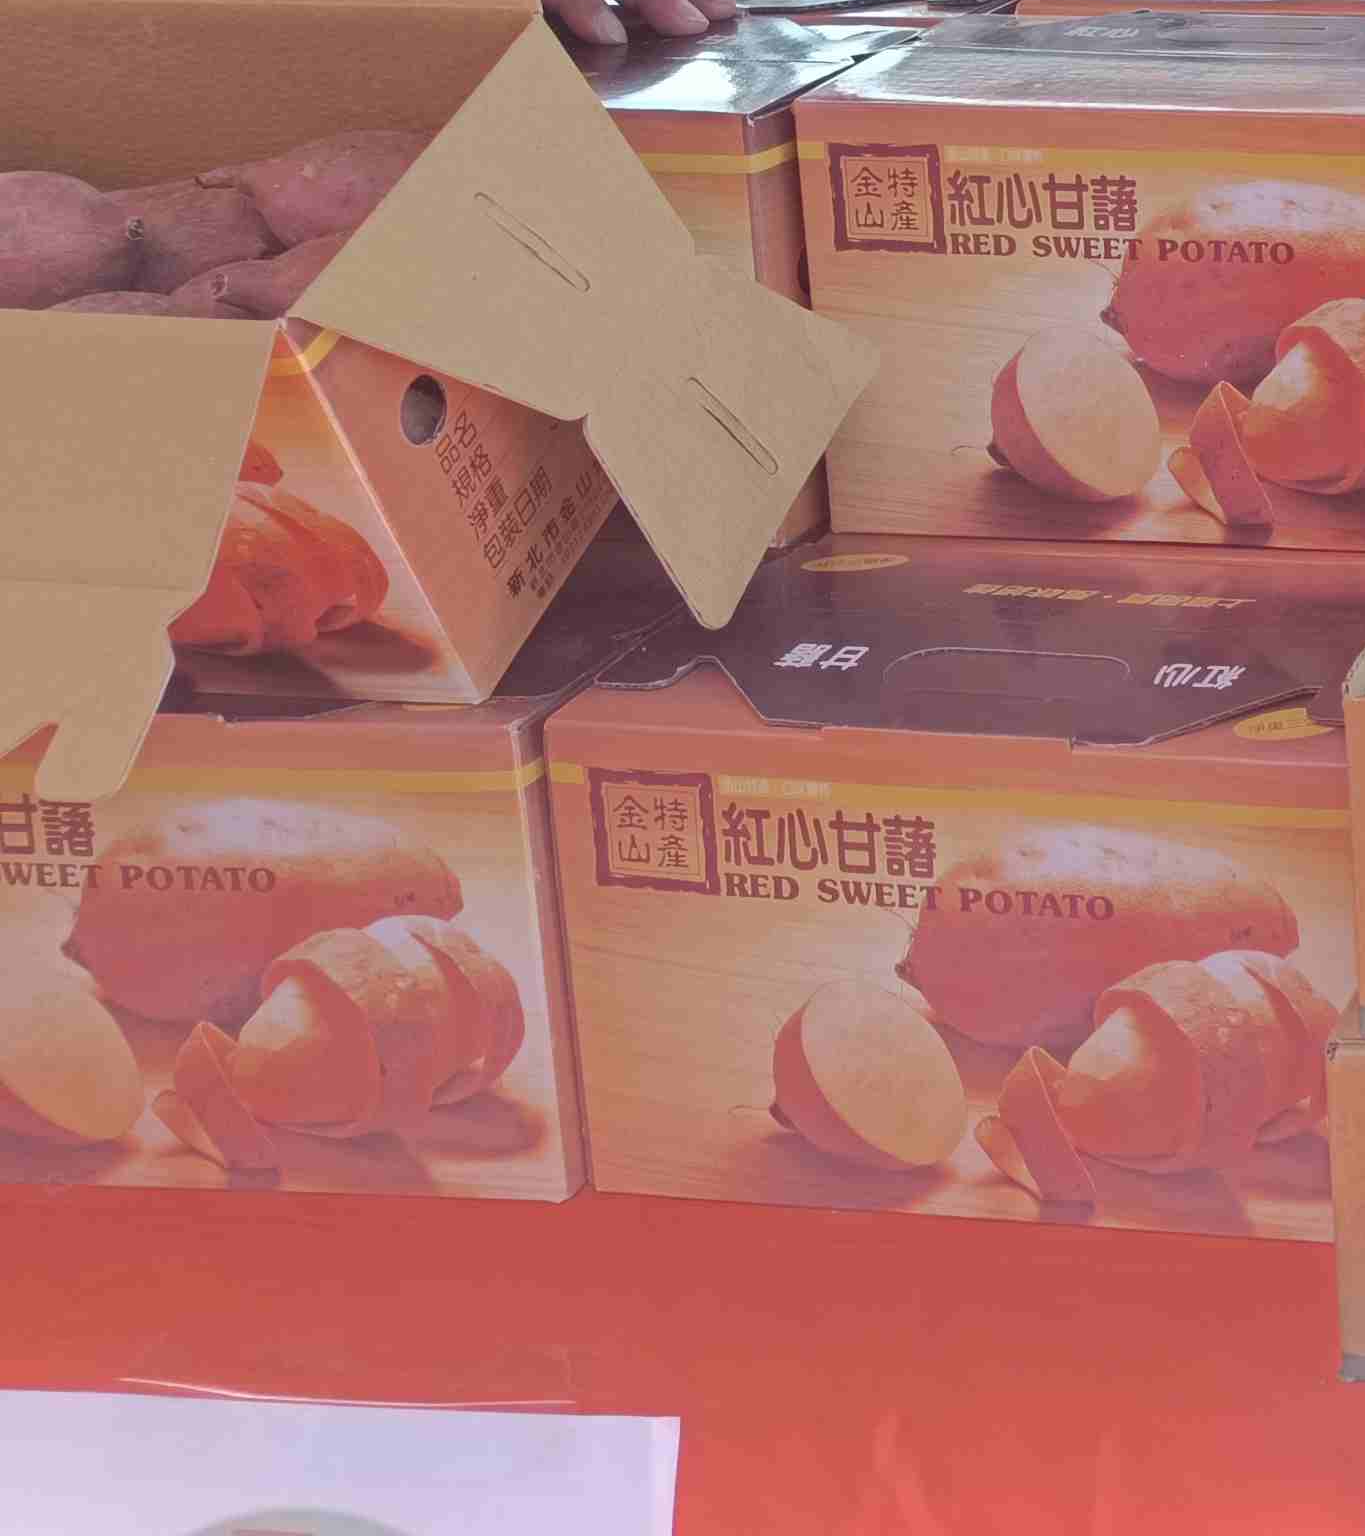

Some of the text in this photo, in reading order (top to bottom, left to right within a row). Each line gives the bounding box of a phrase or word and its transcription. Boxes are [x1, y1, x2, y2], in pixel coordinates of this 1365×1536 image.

[947, 169, 1139, 232] 紅心甘藷
[951, 233, 1296, 265] RED SWEET POTATO
[435, 410, 477, 475] 品名
[452, 443, 492, 508] 規格
[721, 801, 937, 879] 紅心甘藷
[0, 861, 276, 894] WEET POTATO
[724, 872, 1115, 921] RED SWEET POTATO
